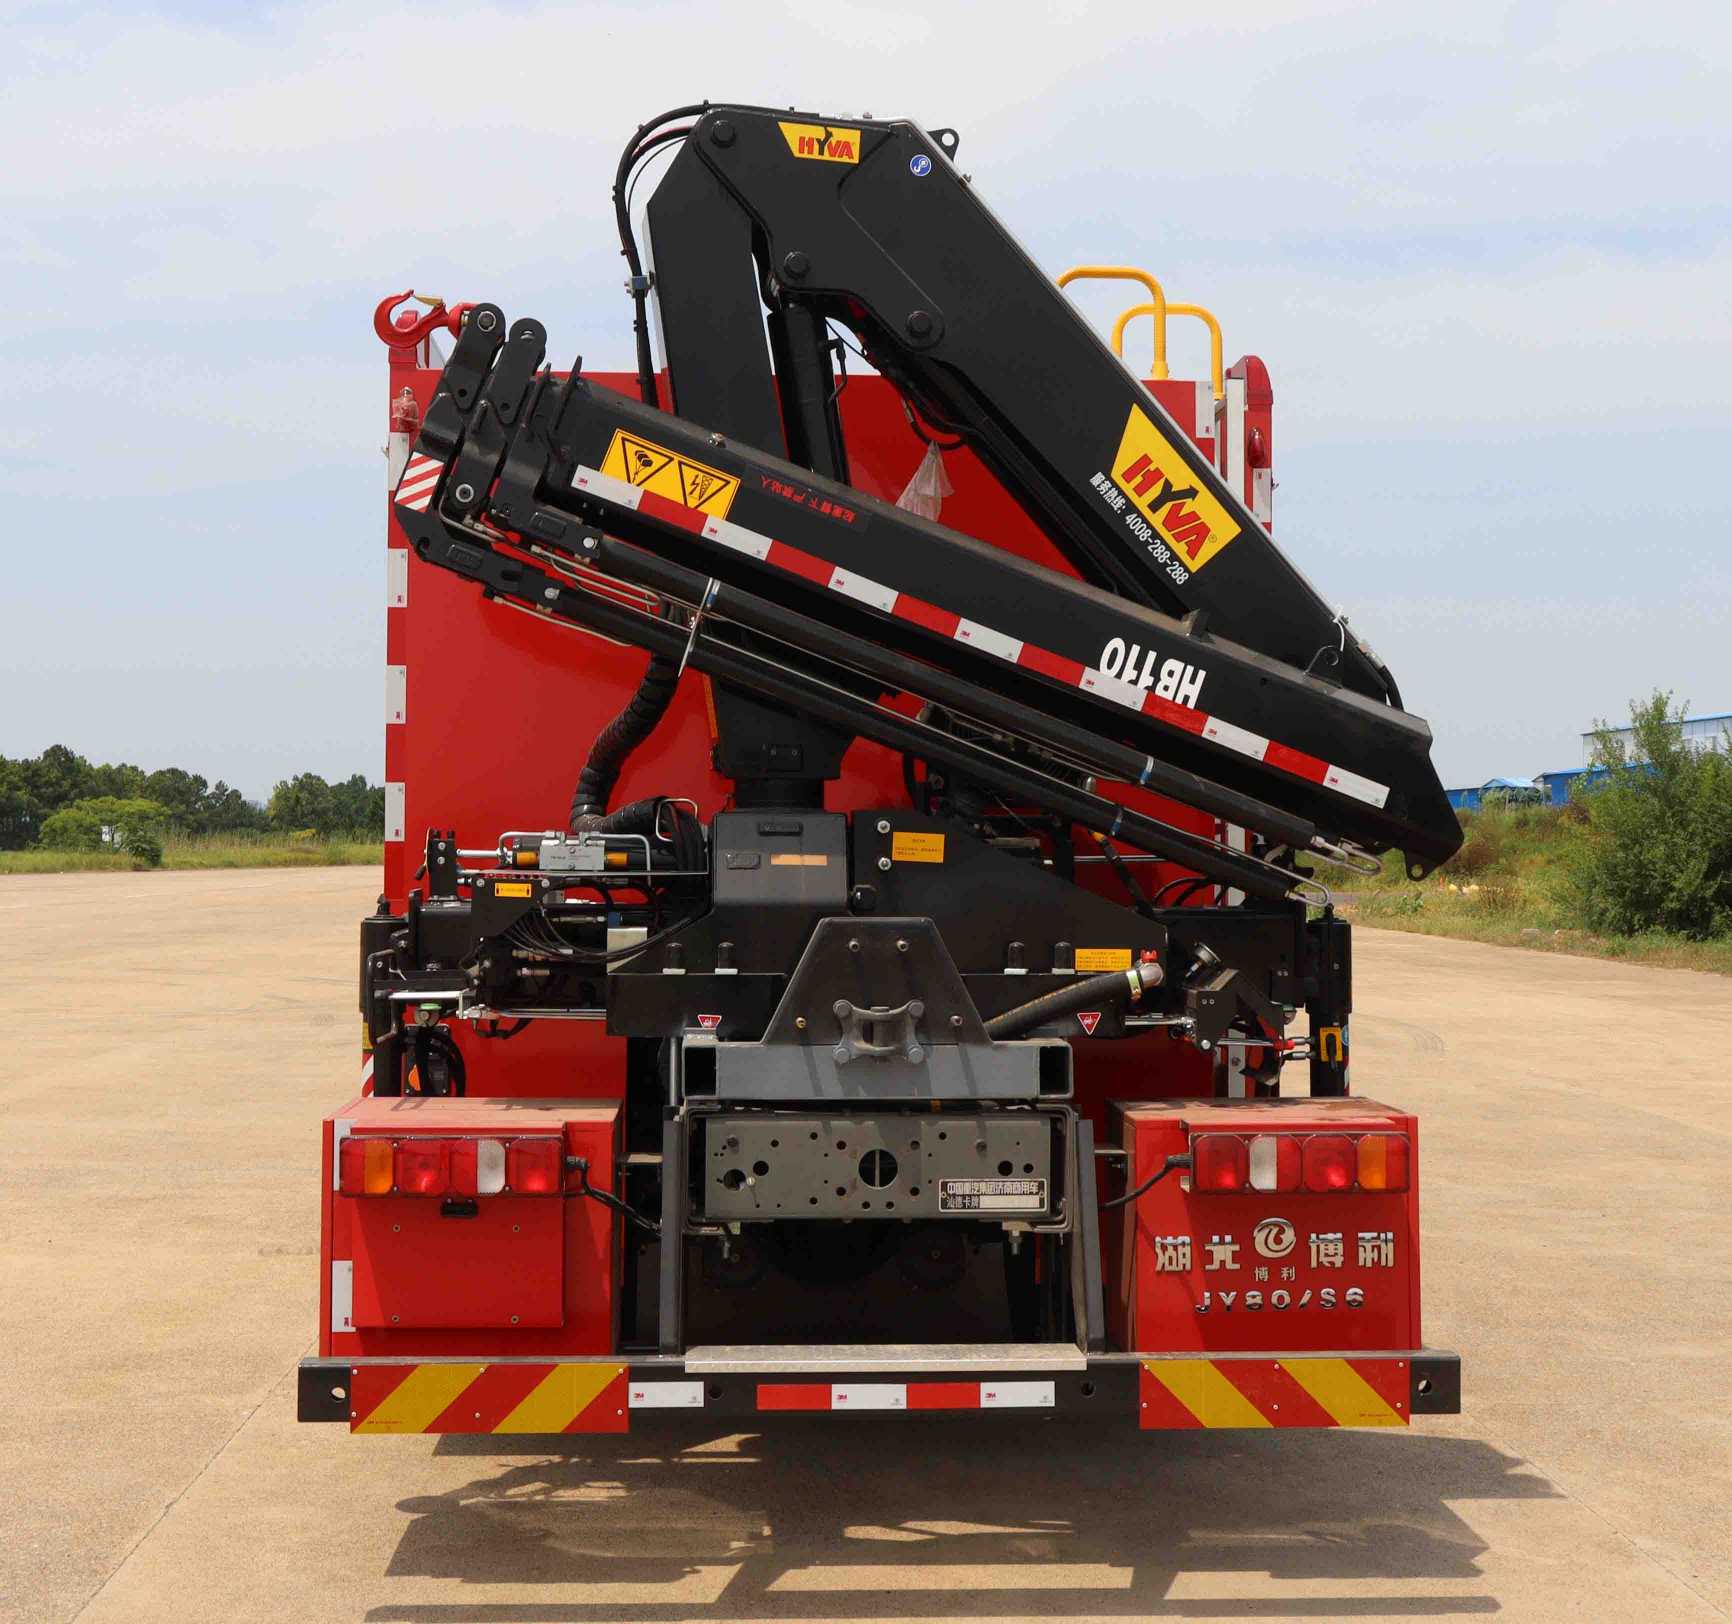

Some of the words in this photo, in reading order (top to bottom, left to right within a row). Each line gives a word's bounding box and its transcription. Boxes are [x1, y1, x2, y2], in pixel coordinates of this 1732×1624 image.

[798, 128, 855, 160] HYVA
[1121, 453, 1212, 561] HYVA
[1125, 512, 1190, 585] 4008-288-288
[1099, 637, 1207, 710] HB110
[1254, 1266, 1296, 1282] 博利
